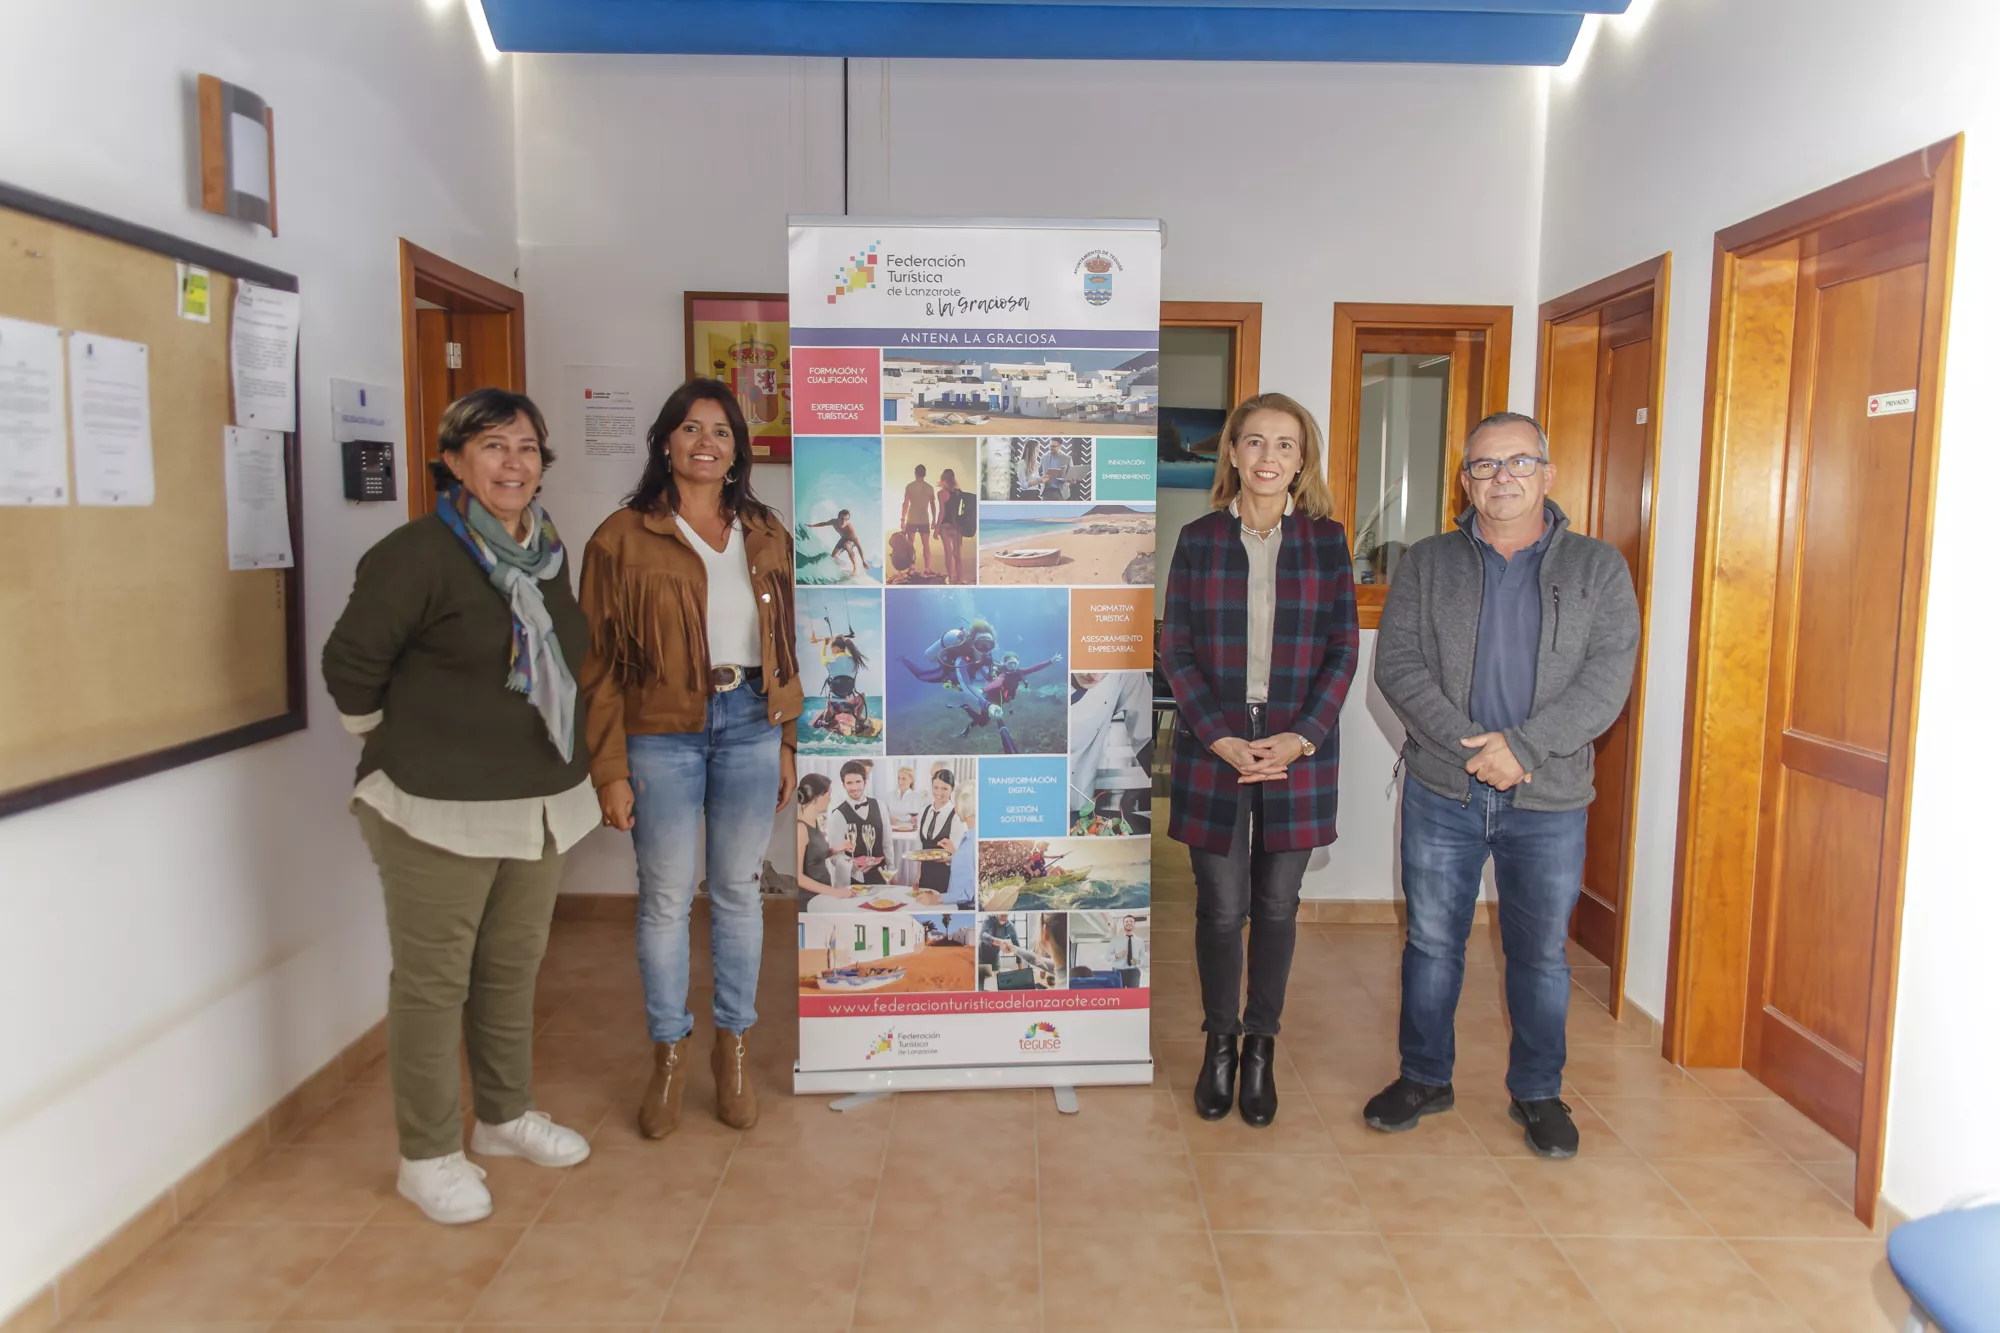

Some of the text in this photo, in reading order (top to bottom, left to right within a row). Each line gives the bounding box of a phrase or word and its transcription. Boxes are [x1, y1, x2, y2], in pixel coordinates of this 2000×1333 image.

[886, 254, 966, 268] Federación
[1073, 250, 1101, 274] AYUNTAMIENTO
[887, 270, 942, 283] Turística
[887, 286, 961, 296] de Lanzarote
[926, 302, 934, 316] &
[900, 332, 1057, 344] ANTENA LA GRACIOSA
[809, 366, 858, 374] FORMACIÓN
[807, 376, 868, 384] CUALIFICACIÓN
[817, 412, 858, 420] TURÍSTICAS
[1096, 614, 1130, 622] TURÍSTICA
[1080, 634, 1143, 642] ASESORAMIENTO
[988, 776, 1058, 784] TRANSFORMACIÓN
[1006, 804, 1039, 814] GESTIÓN
[1000, 815, 1044, 823] SOSTENIBLE
[828, 995, 1121, 1014] www.federacionturisticadelanzarote.com
